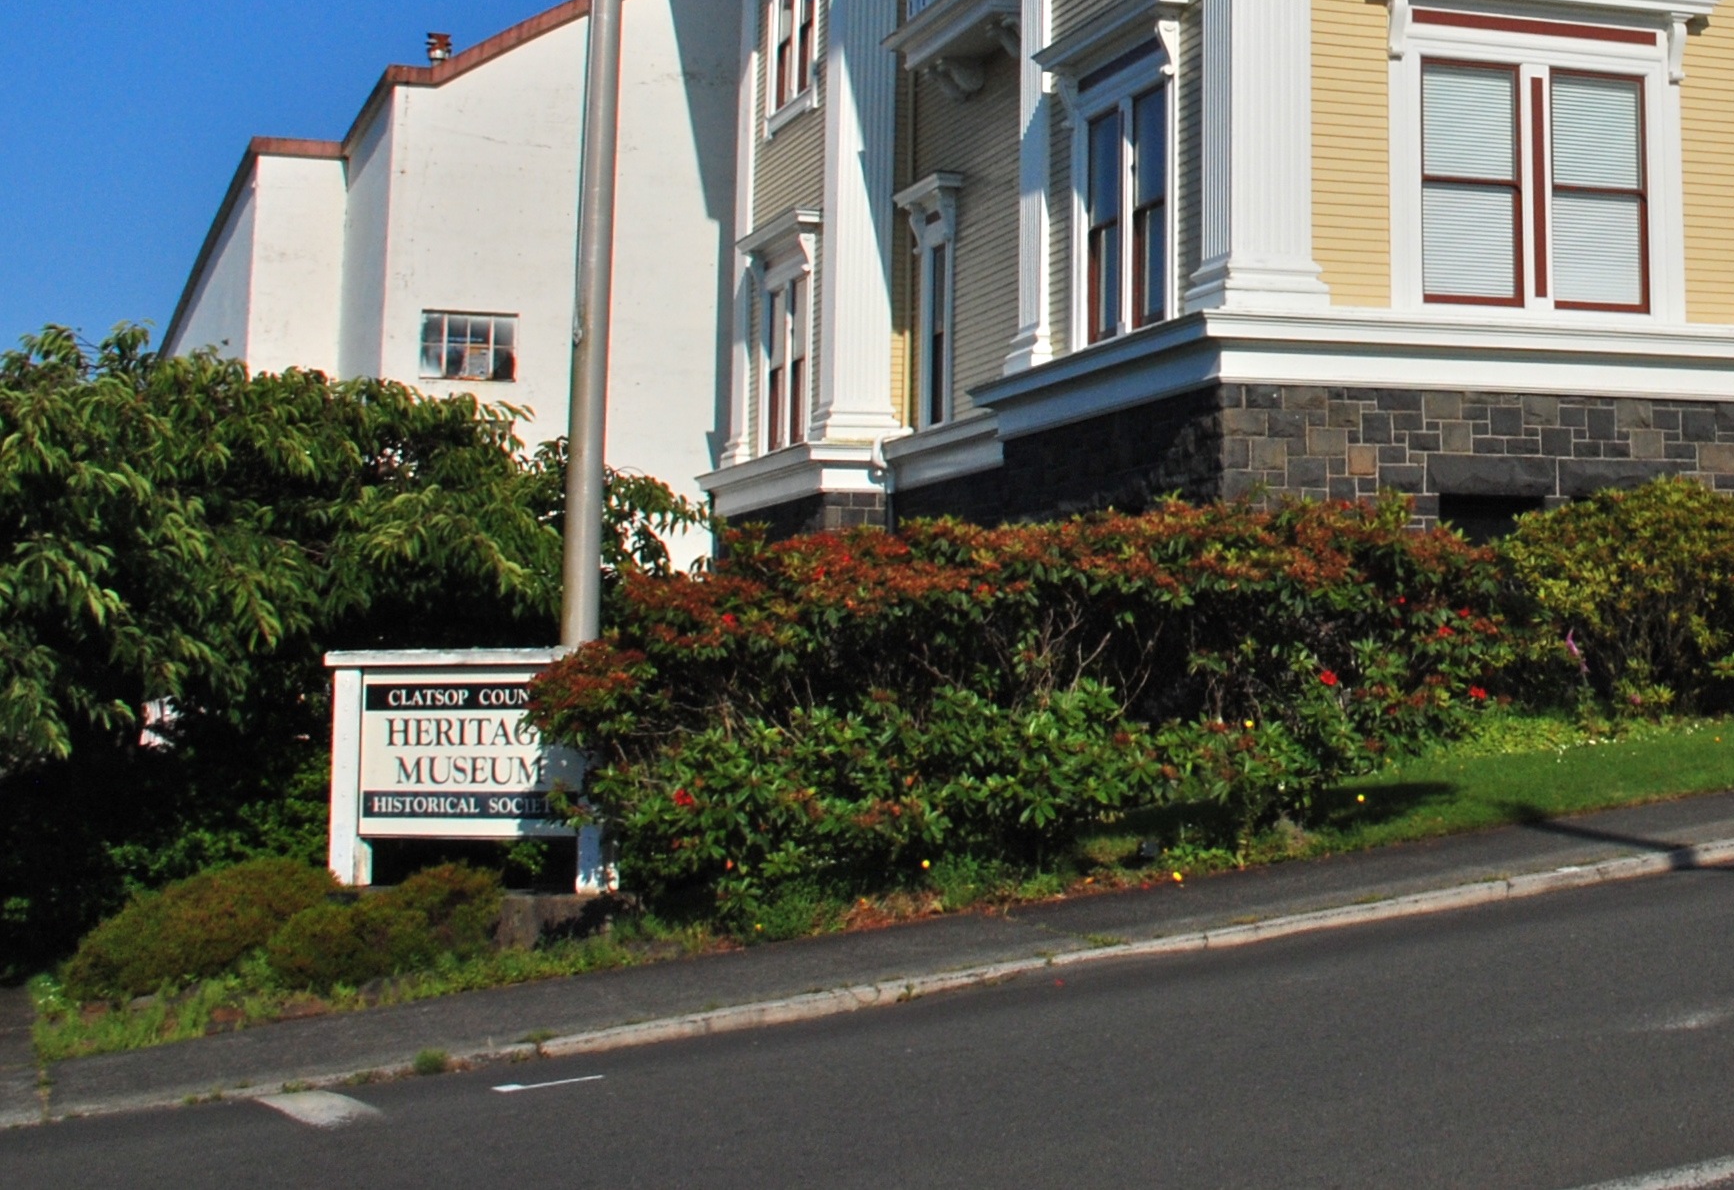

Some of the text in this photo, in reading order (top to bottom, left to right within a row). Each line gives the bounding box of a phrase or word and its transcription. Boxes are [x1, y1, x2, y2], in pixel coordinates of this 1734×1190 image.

[387, 688, 530, 706] CLATSOP COUN
[385, 716, 535, 747] HERITAG
[395, 756, 545, 785] MUSEUM
[372, 796, 550, 814] HISTORICAL SOCIET
